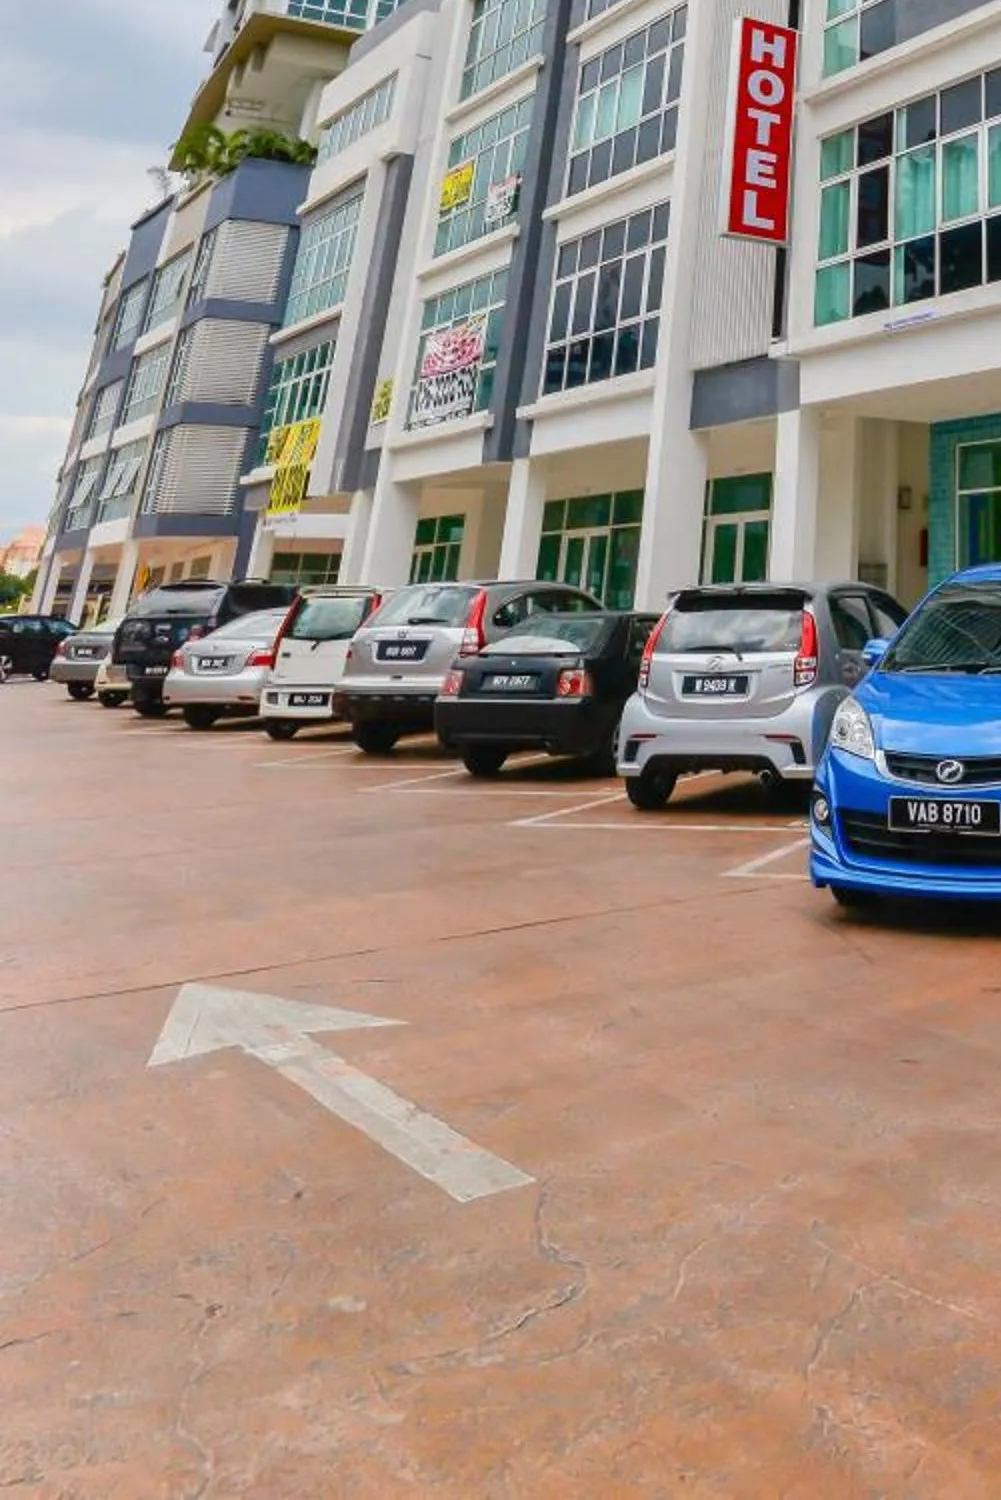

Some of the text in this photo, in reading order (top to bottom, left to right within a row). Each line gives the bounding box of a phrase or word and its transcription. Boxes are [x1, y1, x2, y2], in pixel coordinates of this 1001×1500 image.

[741, 27, 787, 231] HOTEL
[907, 801, 981, 825] VAB 8710
